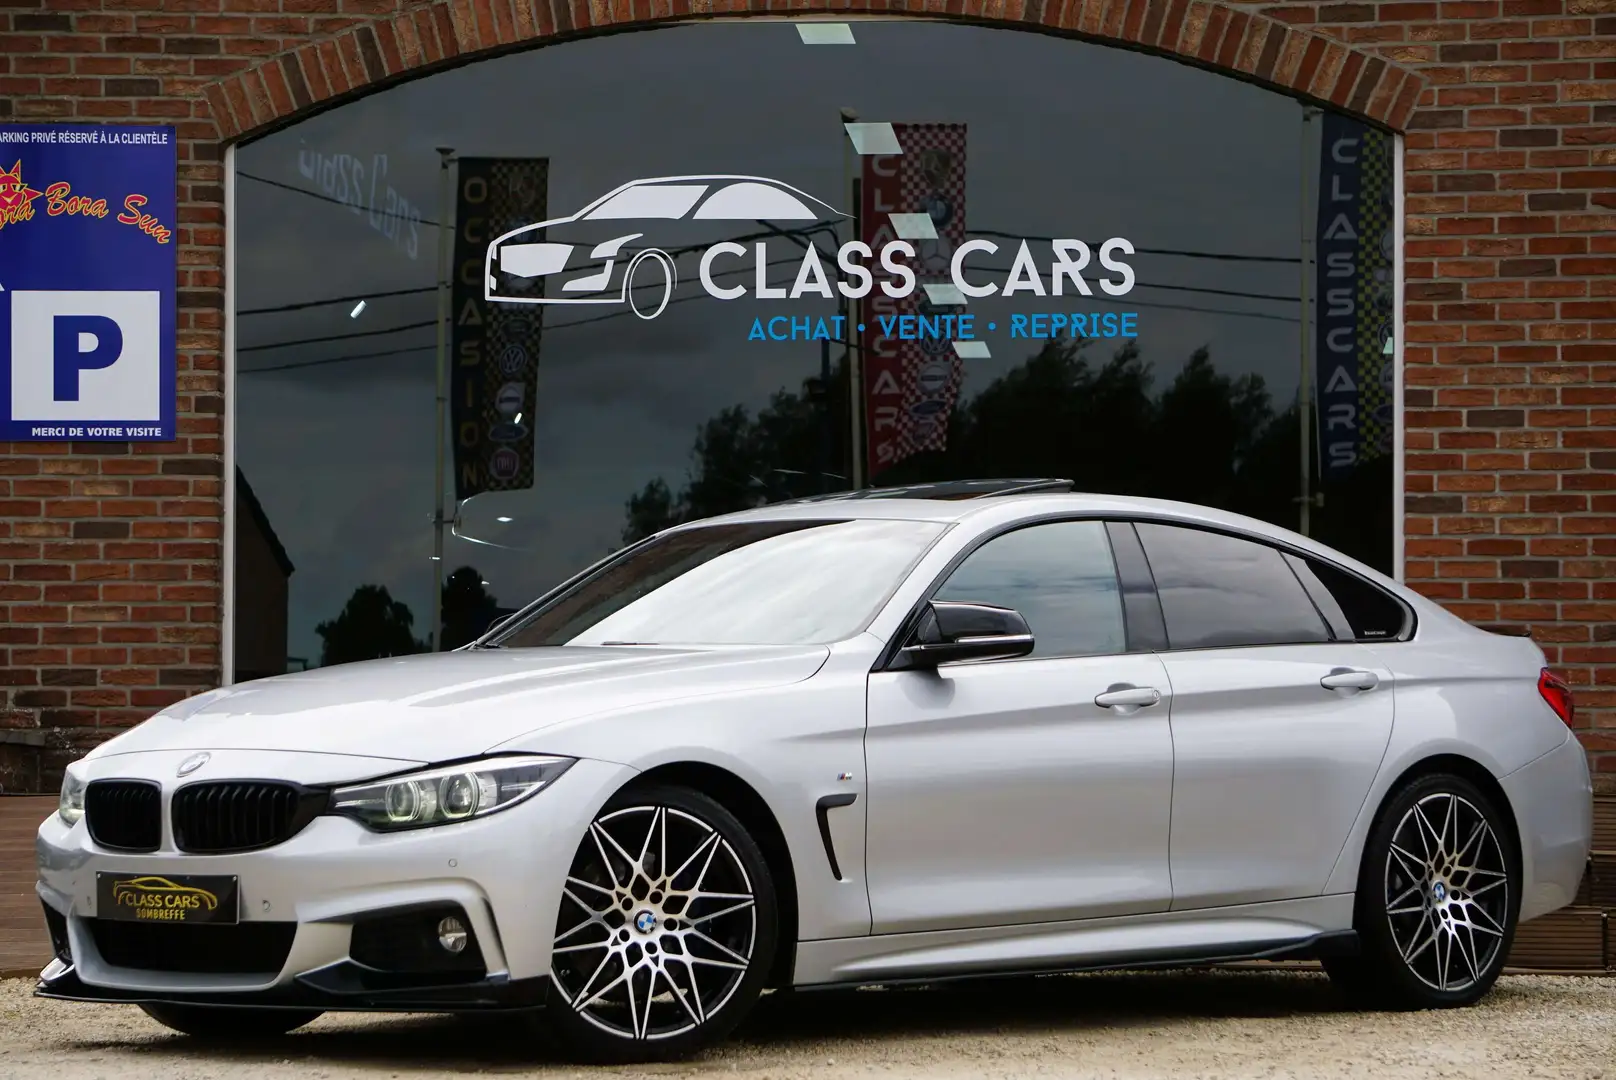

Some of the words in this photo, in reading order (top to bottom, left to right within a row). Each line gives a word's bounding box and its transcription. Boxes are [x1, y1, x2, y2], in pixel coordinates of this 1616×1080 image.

[31, 129, 56, 143] PRIVÉ
[58, 130, 98, 143] RÉSERVÉ
[100, 129, 107, 143] À
[109, 133, 120, 143] LA
[121, 131, 168, 144] CLIENTÈLE
[45, 181, 109, 218] Bora
[117, 194, 171, 244] Sun
[699, 240, 916, 299] CLASS
[950, 237, 1136, 297] CARS
[457, 176, 488, 489] OCCASION
[748, 316, 845, 340] ACHAT
[879, 314, 975, 339] VENTE
[1011, 313, 1138, 338] REPRISE
[53, 315, 123, 401] P
[32, 427, 65, 436] MERCI
[69, 427, 83, 436] DE
[87, 427, 123, 436] VOTRE
[126, 427, 162, 436] VISITE
[126, 893, 162, 907] CLASS
[165, 894, 201, 908] CARS
[136, 908, 185, 920] SOMBREFFE
